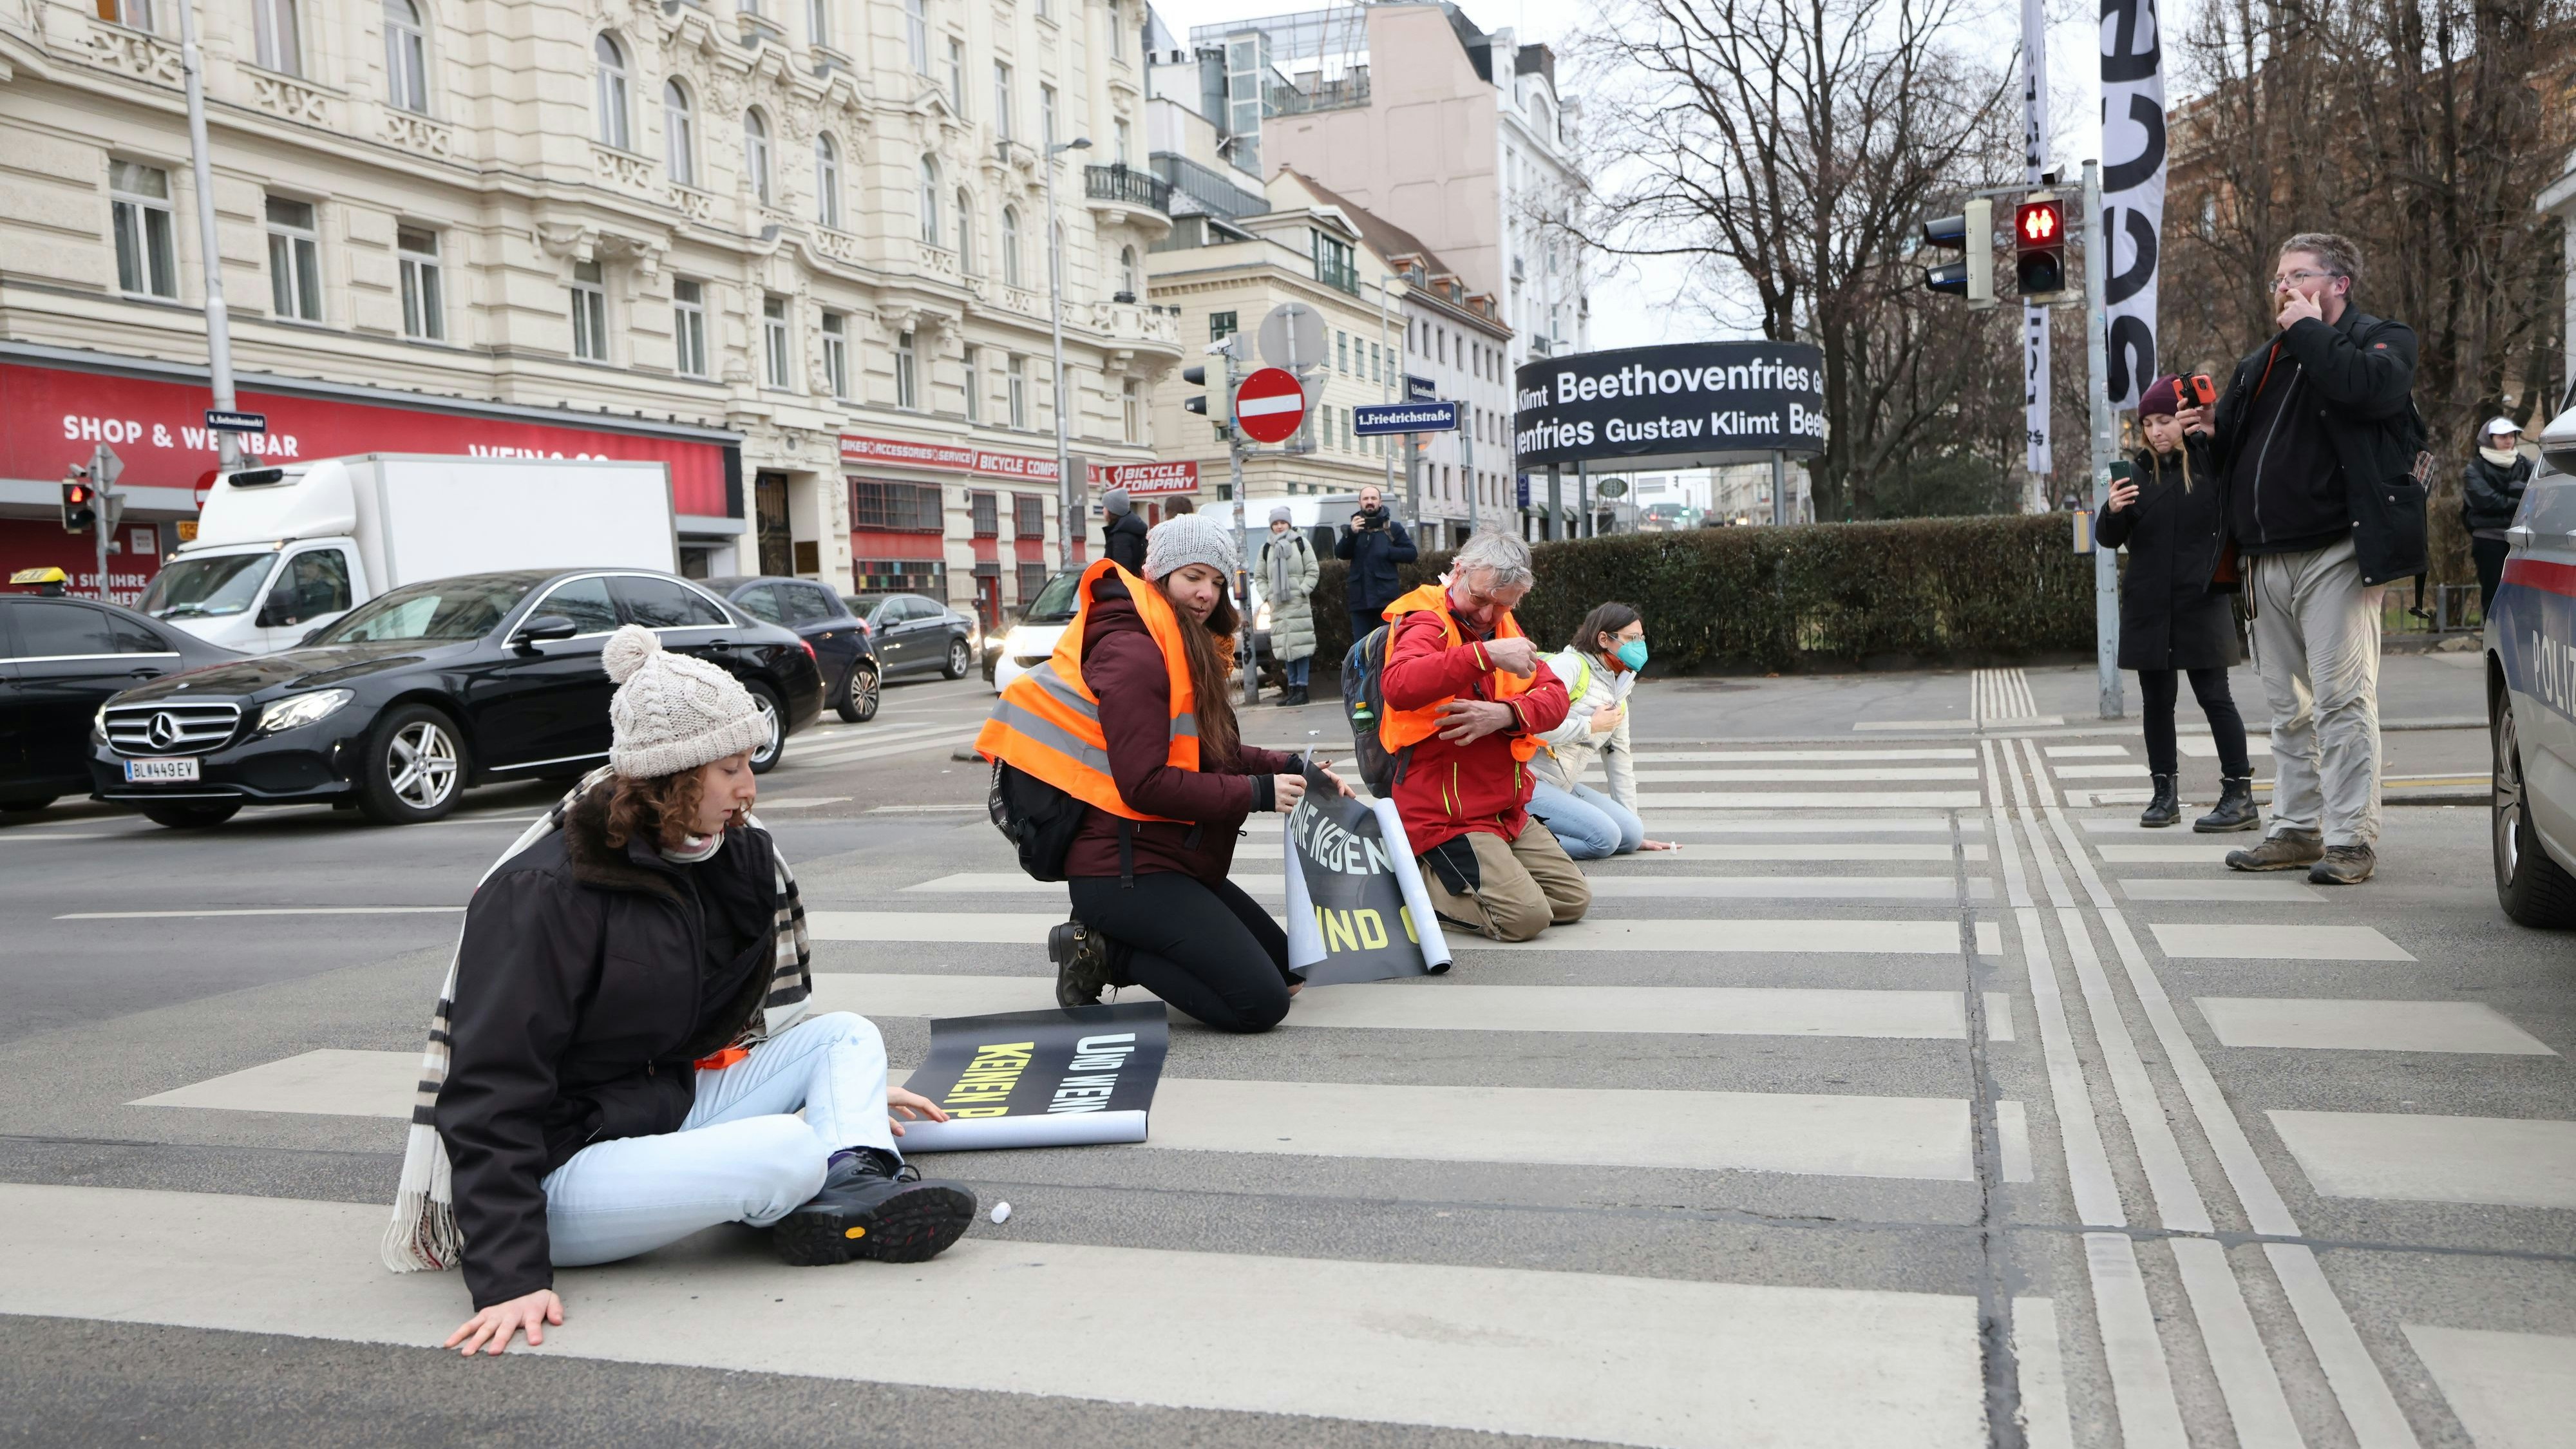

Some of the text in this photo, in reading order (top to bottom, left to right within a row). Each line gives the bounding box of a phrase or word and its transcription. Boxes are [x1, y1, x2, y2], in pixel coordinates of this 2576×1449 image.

[1518, 384, 1549, 412] Klimt
[1557, 357, 1809, 404] Beethovenfries
[63, 415, 299, 457] SHOP & WENBAR
[1605, 415, 1703, 442] Gustav
[1710, 410, 1780, 436] Klimt
[841, 439, 971, 462] BIKES ACCESSORIES SERVICE
[980, 455, 1023, 473] BICYCLE
[1122, 476, 1195, 492] COMPANY
[1124, 464, 1186, 479] BICYCLE
[109, 574, 147, 587] IHRE
[1310, 815, 1396, 876] NEUEN
[1068, 1032, 1136, 1071] UND
[943, 1041, 1035, 1104] KEINEN
